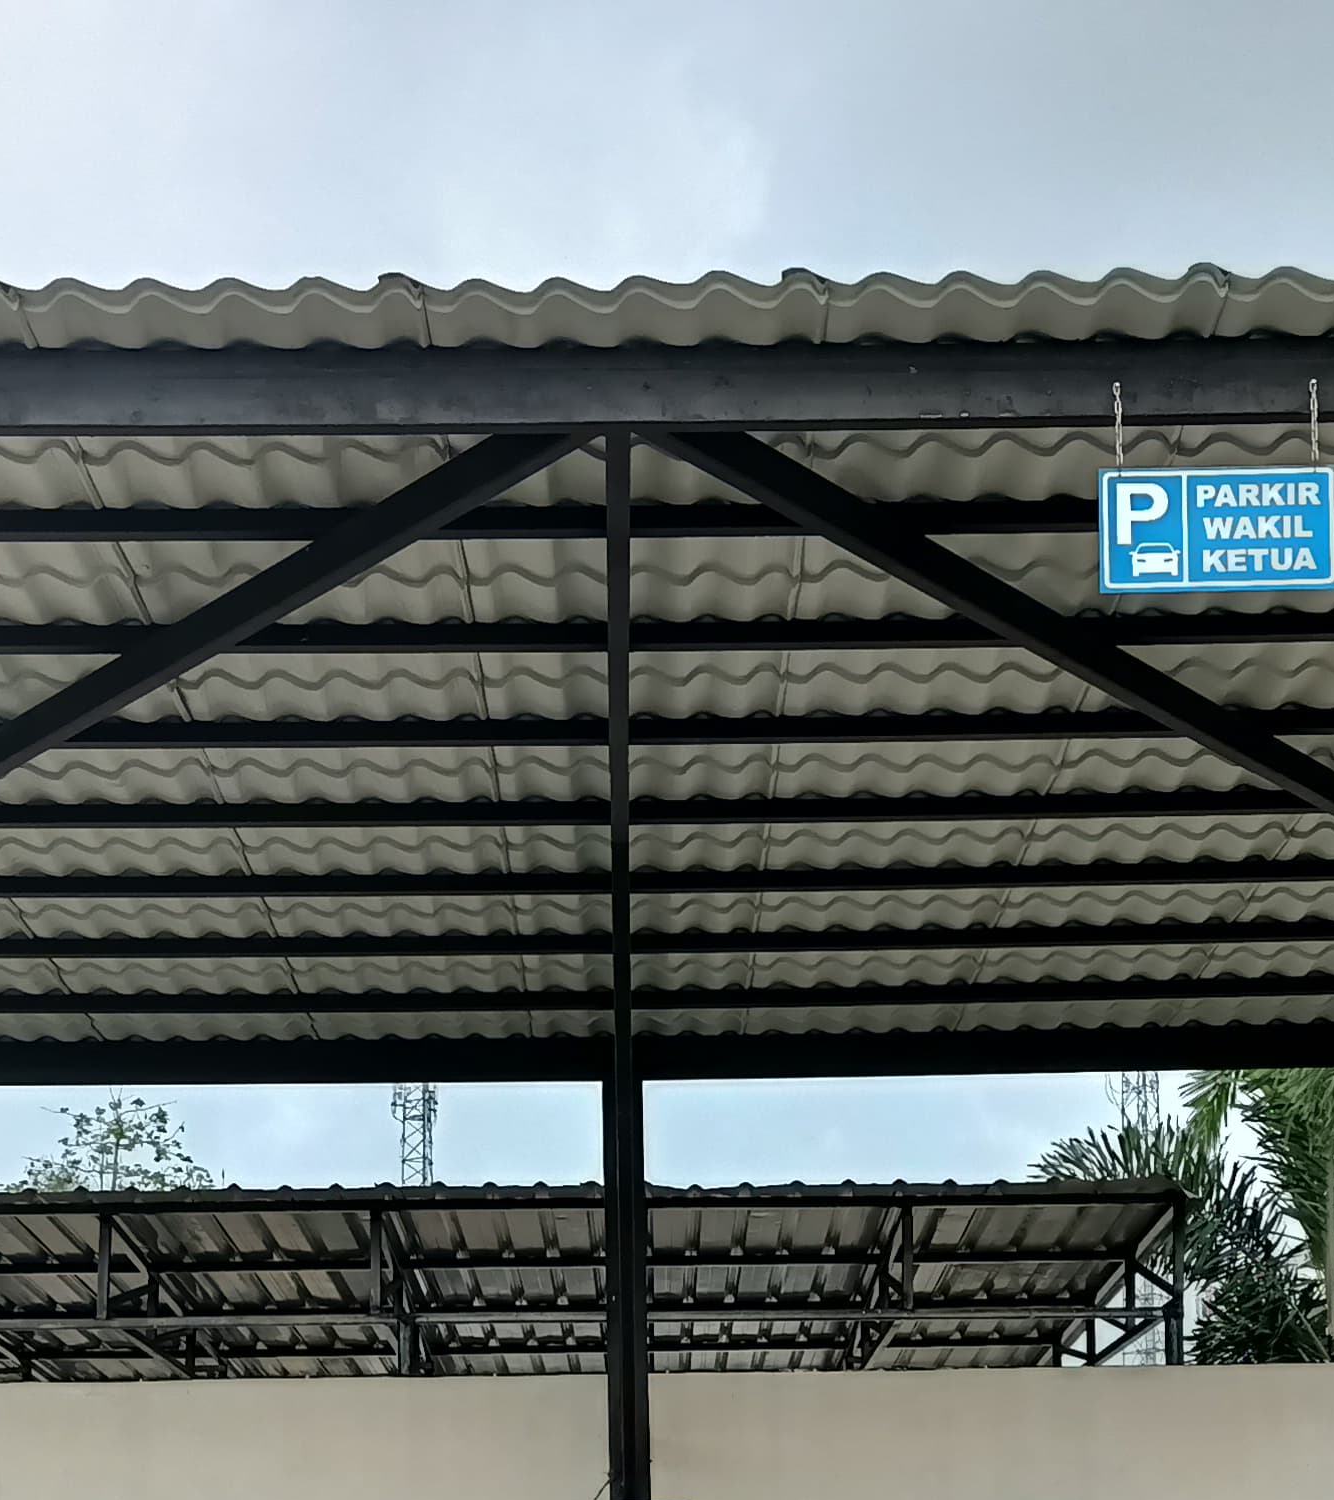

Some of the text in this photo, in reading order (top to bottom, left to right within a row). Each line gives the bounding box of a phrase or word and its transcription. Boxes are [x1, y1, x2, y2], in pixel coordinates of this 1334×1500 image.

[1196, 482, 1321, 508] PARKIR
[1116, 482, 1168, 545] P
[1203, 515, 1313, 540] WAKIL
[1202, 547, 1317, 573] KETUA
